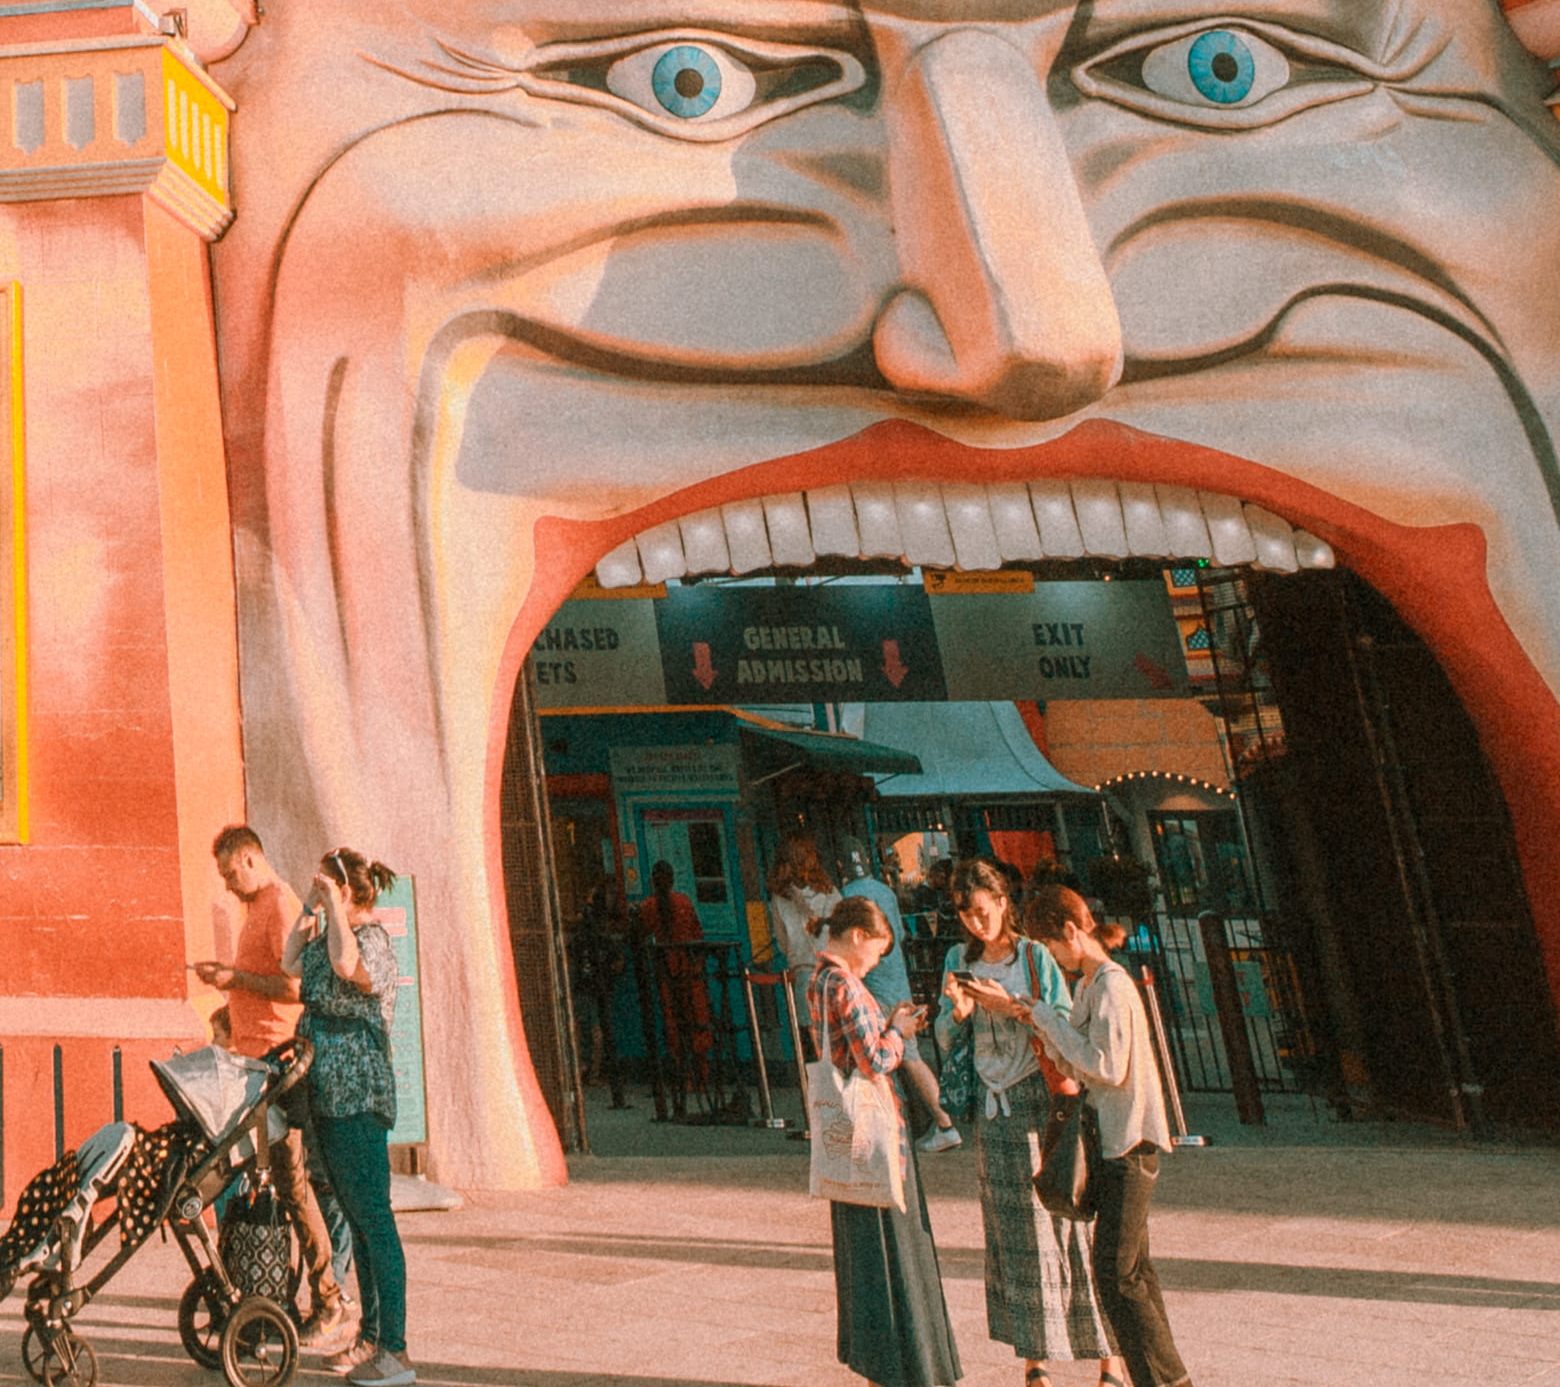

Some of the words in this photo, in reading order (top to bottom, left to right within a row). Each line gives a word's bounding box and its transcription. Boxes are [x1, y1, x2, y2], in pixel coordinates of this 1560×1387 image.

[743, 625, 846, 650] GENERAL
[1032, 623, 1084, 646] EXIT
[737, 658, 863, 683] ADMISSION
[1039, 656, 1091, 678] ONLY
